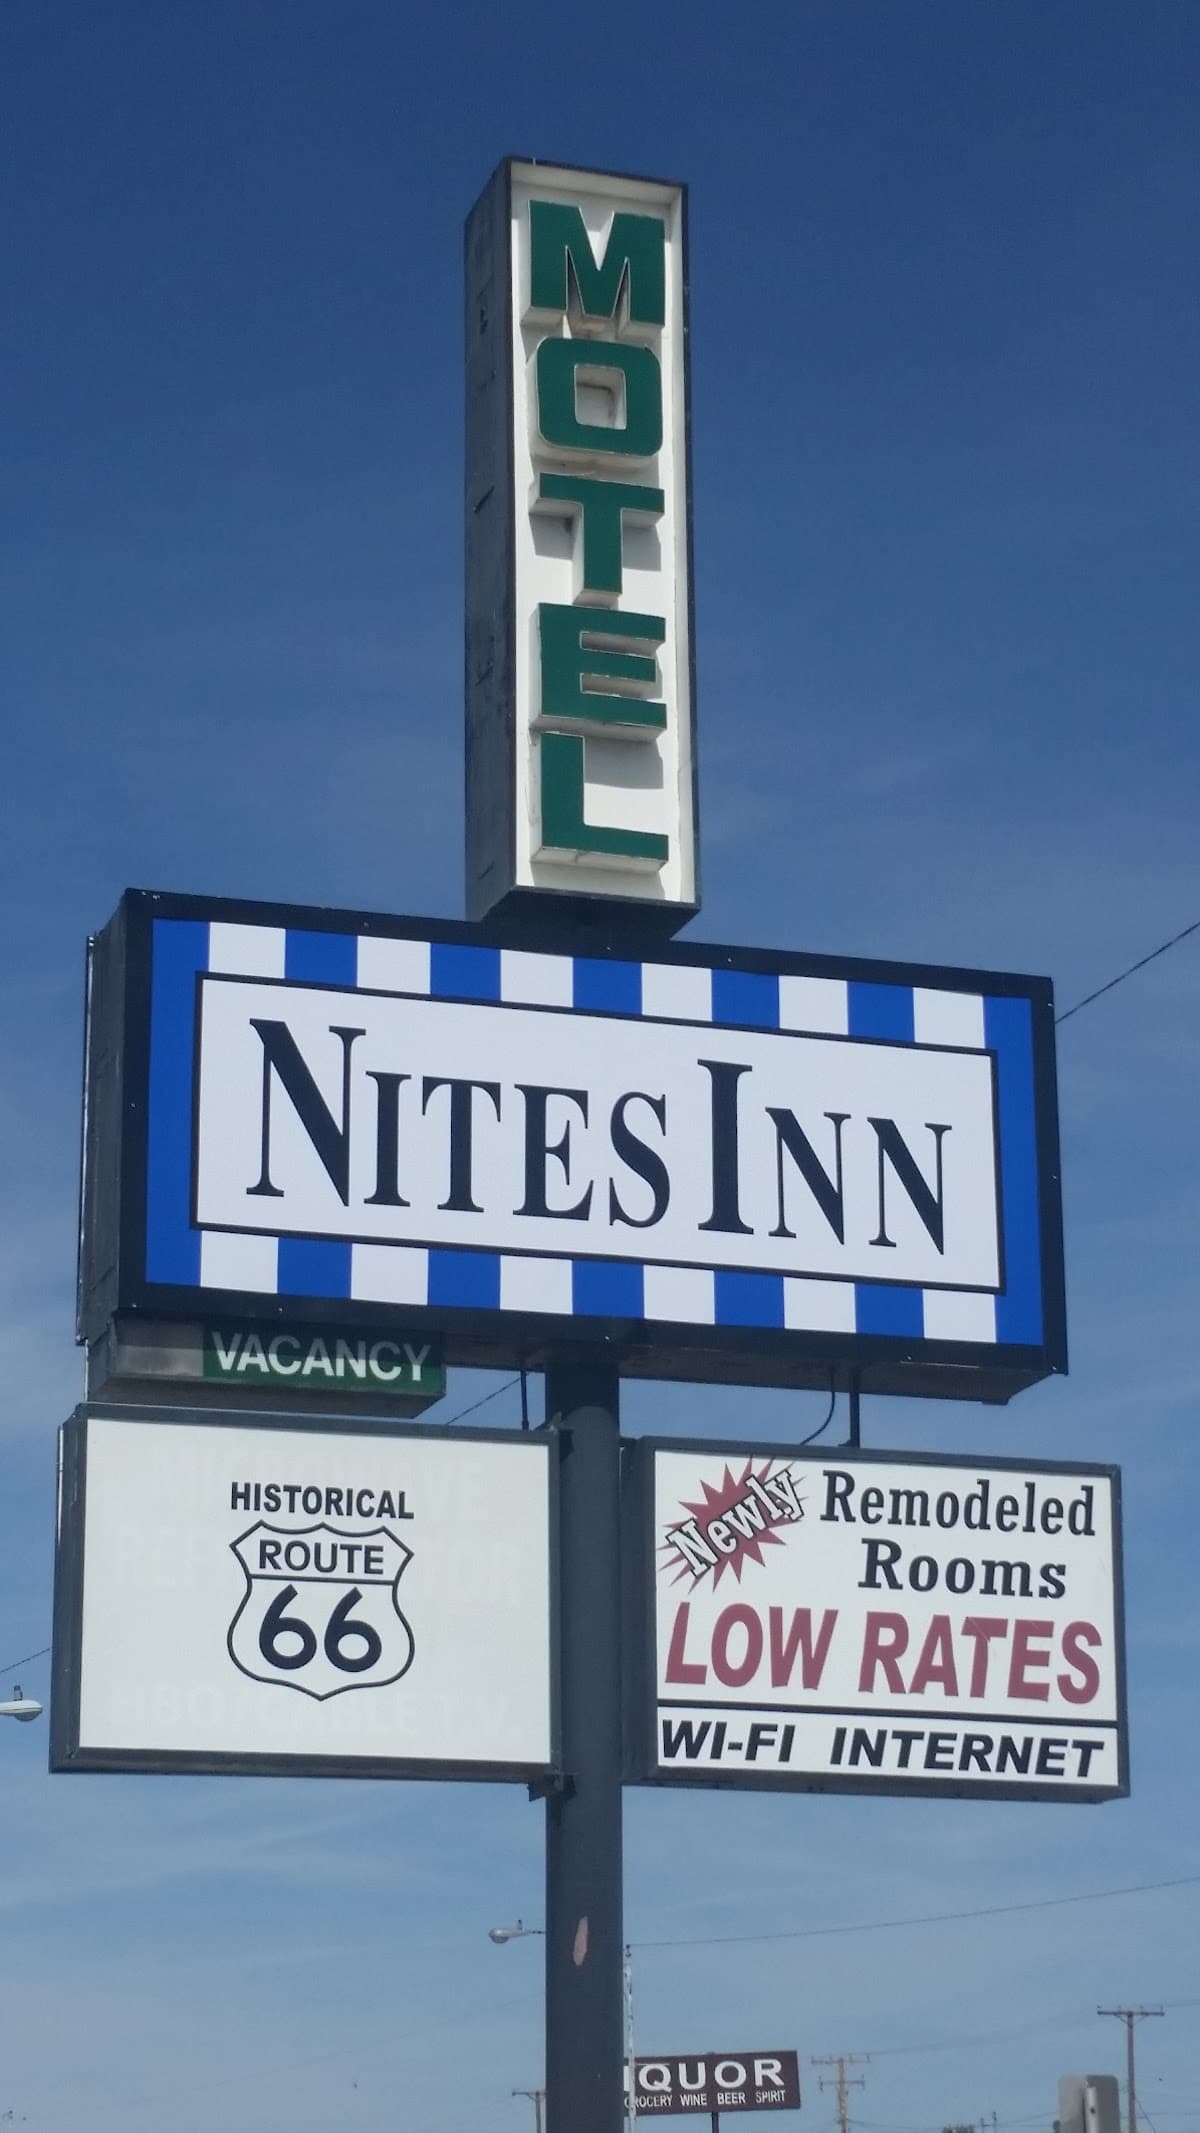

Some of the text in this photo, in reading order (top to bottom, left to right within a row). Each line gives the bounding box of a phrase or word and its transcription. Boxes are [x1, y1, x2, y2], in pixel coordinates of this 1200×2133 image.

[531, 201, 668, 859] MOTEL
[212, 1331, 432, 1382] VACANCY
[231, 1482, 414, 1520] HISTORICAL
[665, 1469, 804, 1579] Newly
[820, 1470, 1096, 1536] Remodeled
[258, 1540, 384, 1575] ROUTE
[858, 1538, 1067, 1599] Rooms
[259, 1584, 382, 1673] 66
[665, 1602, 1102, 1704] LOW RATES
[661, 1719, 1105, 1778] WI-FI INTERNET
[623, 2058, 785, 2092] IQUOR
[679, 2093, 708, 2107] WINE
[717, 2091, 747, 2105] BEER
[755, 2089, 786, 2104] SPIRIT
